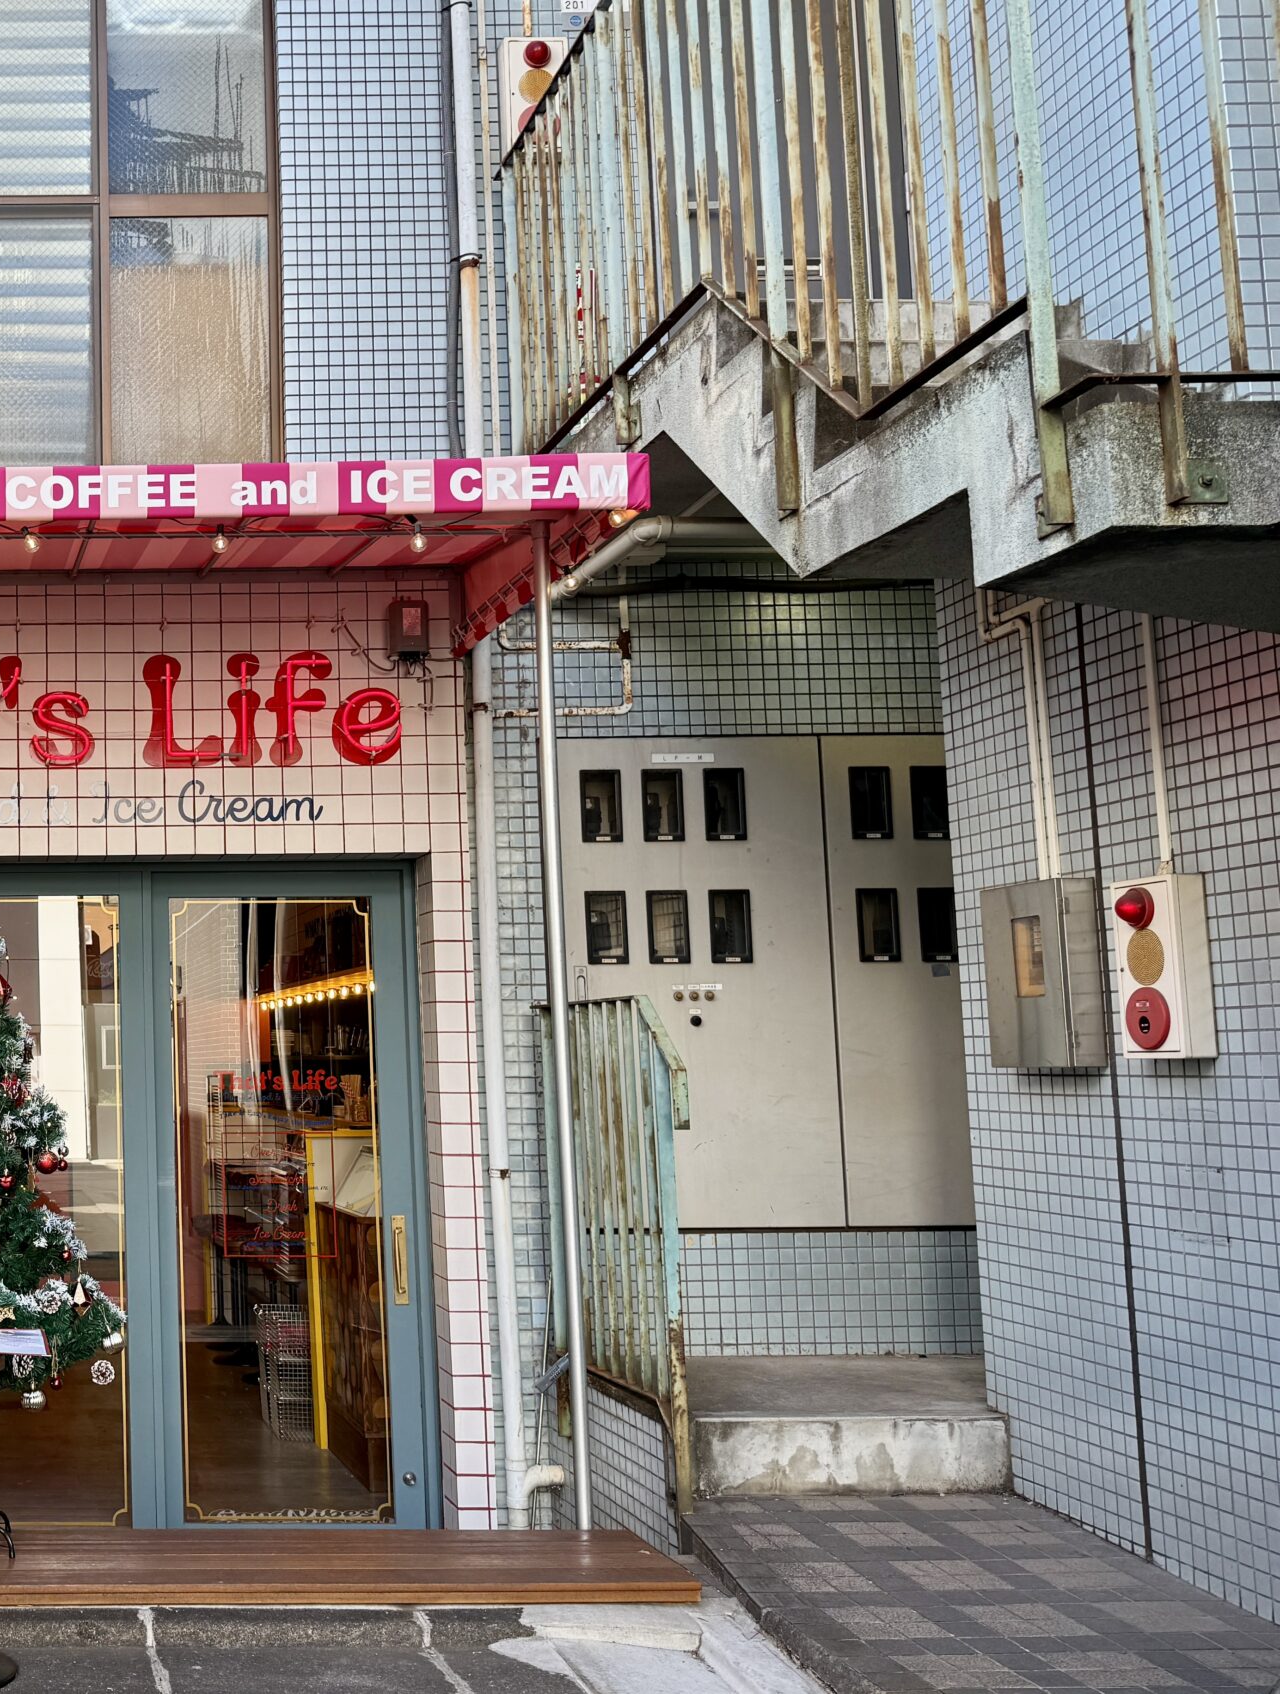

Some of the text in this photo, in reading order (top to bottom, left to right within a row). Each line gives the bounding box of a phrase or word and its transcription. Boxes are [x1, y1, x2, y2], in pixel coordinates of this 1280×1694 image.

[564, 0, 585, 10] 201
[5, 473, 198, 510] COFFEE
[230, 470, 318, 506] and
[350, 468, 432, 504] ICE
[449, 464, 629, 502] CREAM
[142, 650, 402, 767] Life
[90, 780, 165, 826] Ice
[177, 779, 324, 824] Cream
[292, 1069, 338, 1091] Life
[253, 1225, 310, 1241] Ice Cream
